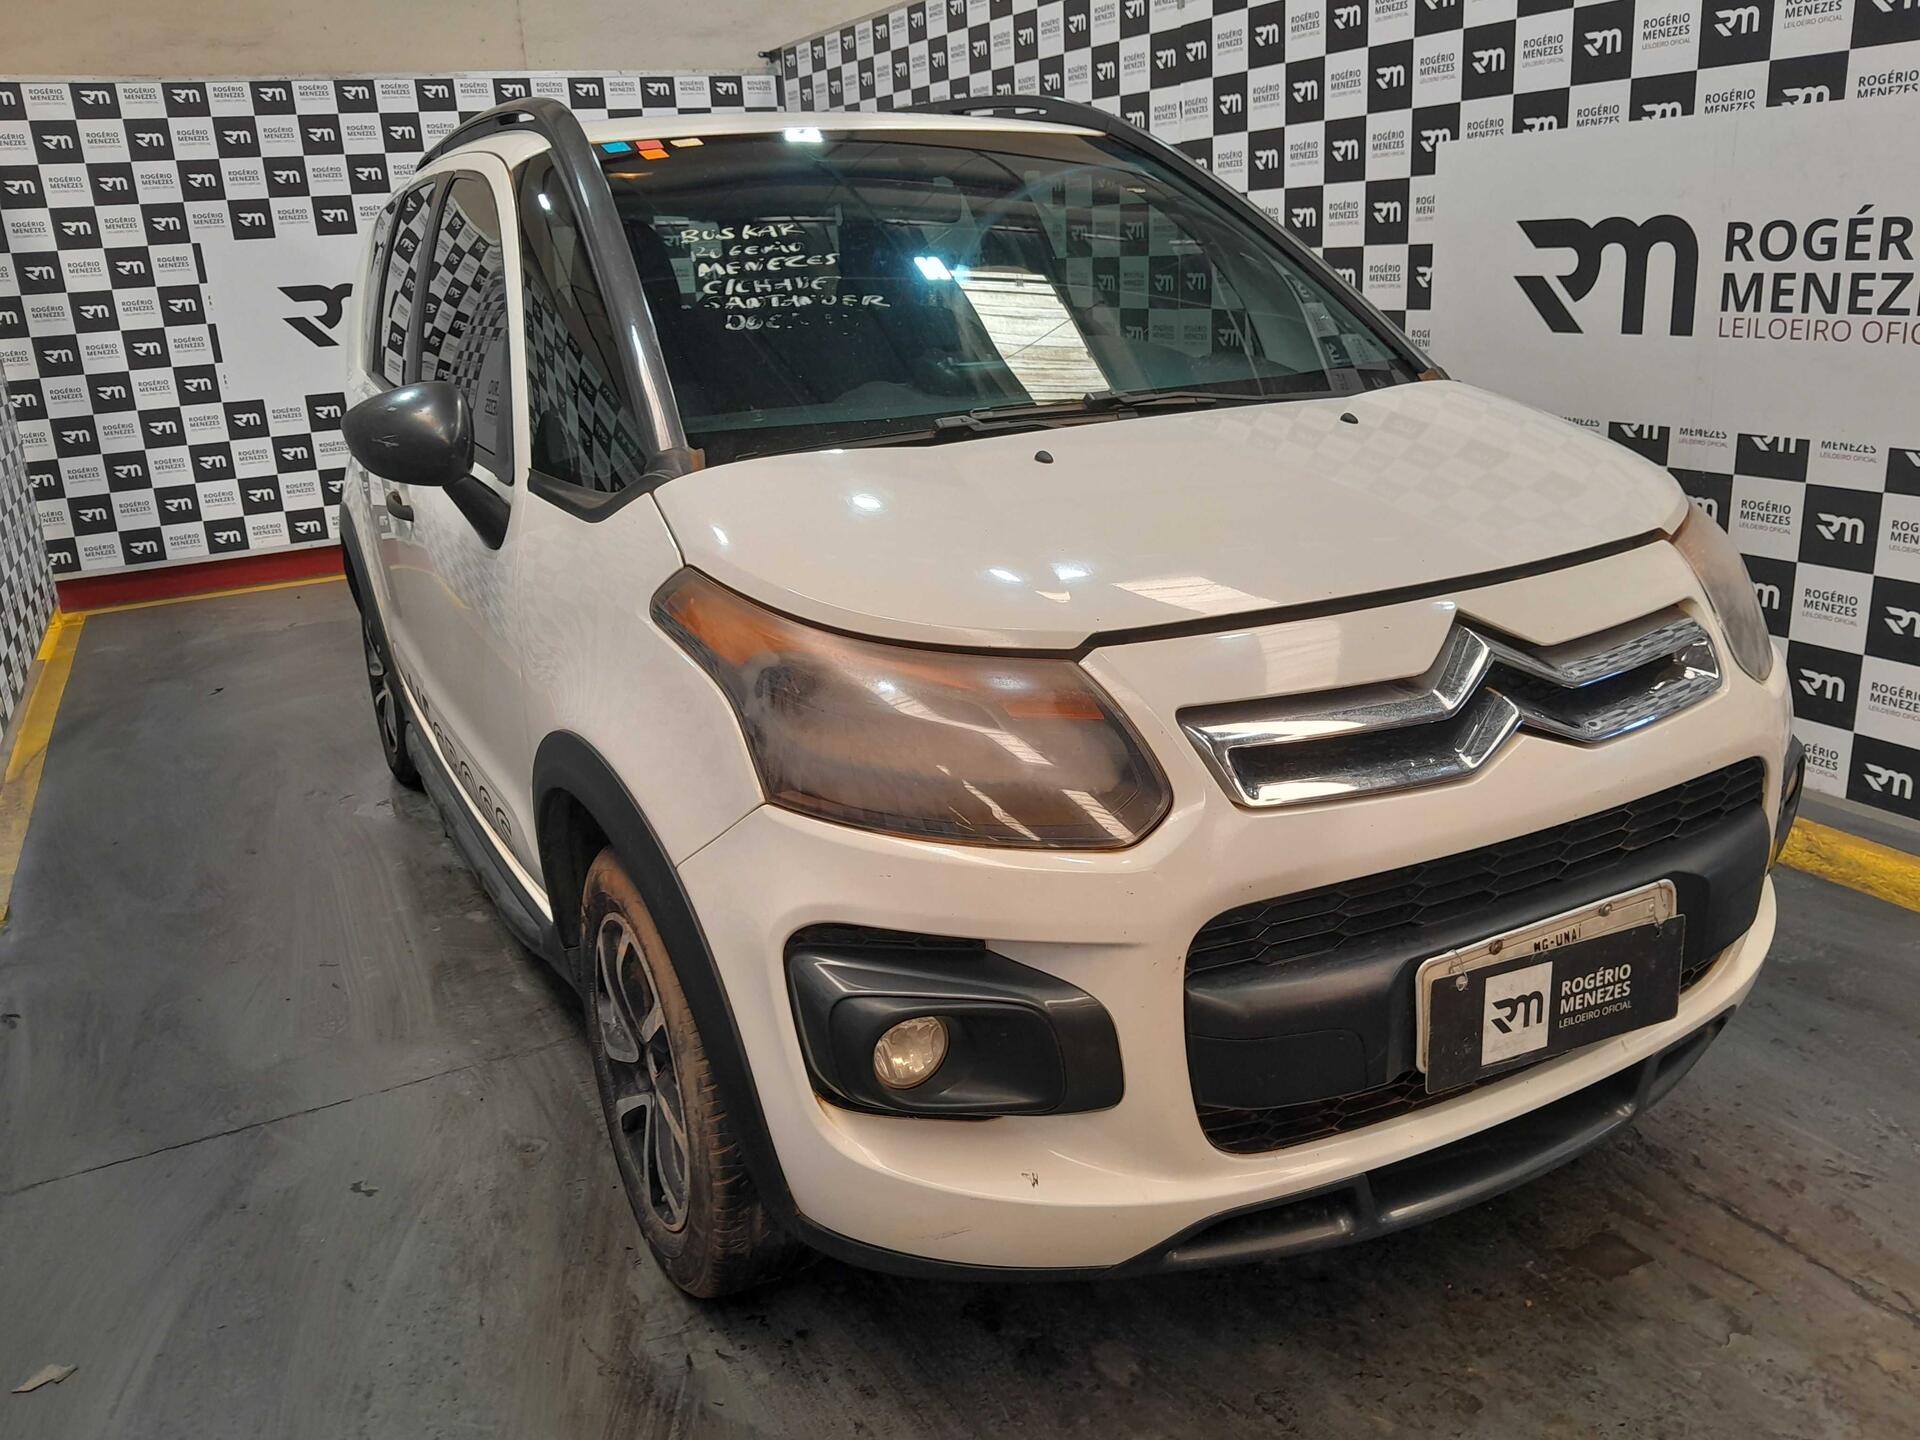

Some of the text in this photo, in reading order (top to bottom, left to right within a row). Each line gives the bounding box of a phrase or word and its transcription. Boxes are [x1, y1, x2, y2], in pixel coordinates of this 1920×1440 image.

[1375, 0, 1408, 17] MENEZES
[1785, 0, 1844, 19] MENEZES
[1291, 11, 1320, 24] ROGÉRIO
[1643, 12, 1691, 29] ROGÉRIO
[1291, 20, 1320, 34] MENEZES
[1642, 23, 1691, 42] MENEZES
[1217, 28, 1243, 41] ROGÉRIO
[1218, 37, 1243, 50] MENEZES
[1522, 34, 1564, 50] ROGÉRIO
[1420, 53, 1455, 67] ROGÉRIO
[1522, 45, 1563, 61] MENEZES
[1331, 69, 1361, 82] ROGÉRIO
[1420, 63, 1455, 78] MENEZES
[1859, 68, 1920, 86] ROGÉRIO
[1253, 83, 1280, 95] ROGÉRIO
[1331, 78, 1361, 92] MENEZES
[1253, 92, 1280, 104] MENEZES
[1705, 88, 1757, 104] ROGÉRIO
[1576, 105, 1620, 118] ROGÉRIO
[1467, 118, 1504, 131] ROGÉRIO
[1372, 130, 1405, 142] ROGÉRIO
[1290, 141, 1318, 151] ROGÉRIO
[1372, 140, 1405, 152] MENEZES
[1218, 150, 1243, 160] ROGÉRIO
[1290, 150, 1318, 161] MENEZES
[1218, 158, 1243, 169] MENEZES
[1329, 200, 1359, 210] ROGÉRIO
[1329, 210, 1359, 220] MENEZES
[1725, 204, 1919, 262] ROGÉR
[1370, 263, 1401, 272] ROGÉRIO
[1370, 274, 1401, 282] MENEZES
[1718, 317, 1852, 342] LEILOEIRO
[1740, 500, 1792, 515] ROGÉRIO
[1740, 510, 1791, 527] MENEZES
[1804, 588, 1859, 607] ROGÉRIO
[1803, 599, 1858, 619] MENEZES
[1804, 743, 1839, 761] GÉRIO
[1804, 755, 1839, 771] NEZES
[1561, 964, 1632, 995] ROGÉRIO
[1560, 980, 1631, 1014] MENEZES
[1559, 1000, 1632, 1029] LEILOEIRO OFICIAL
